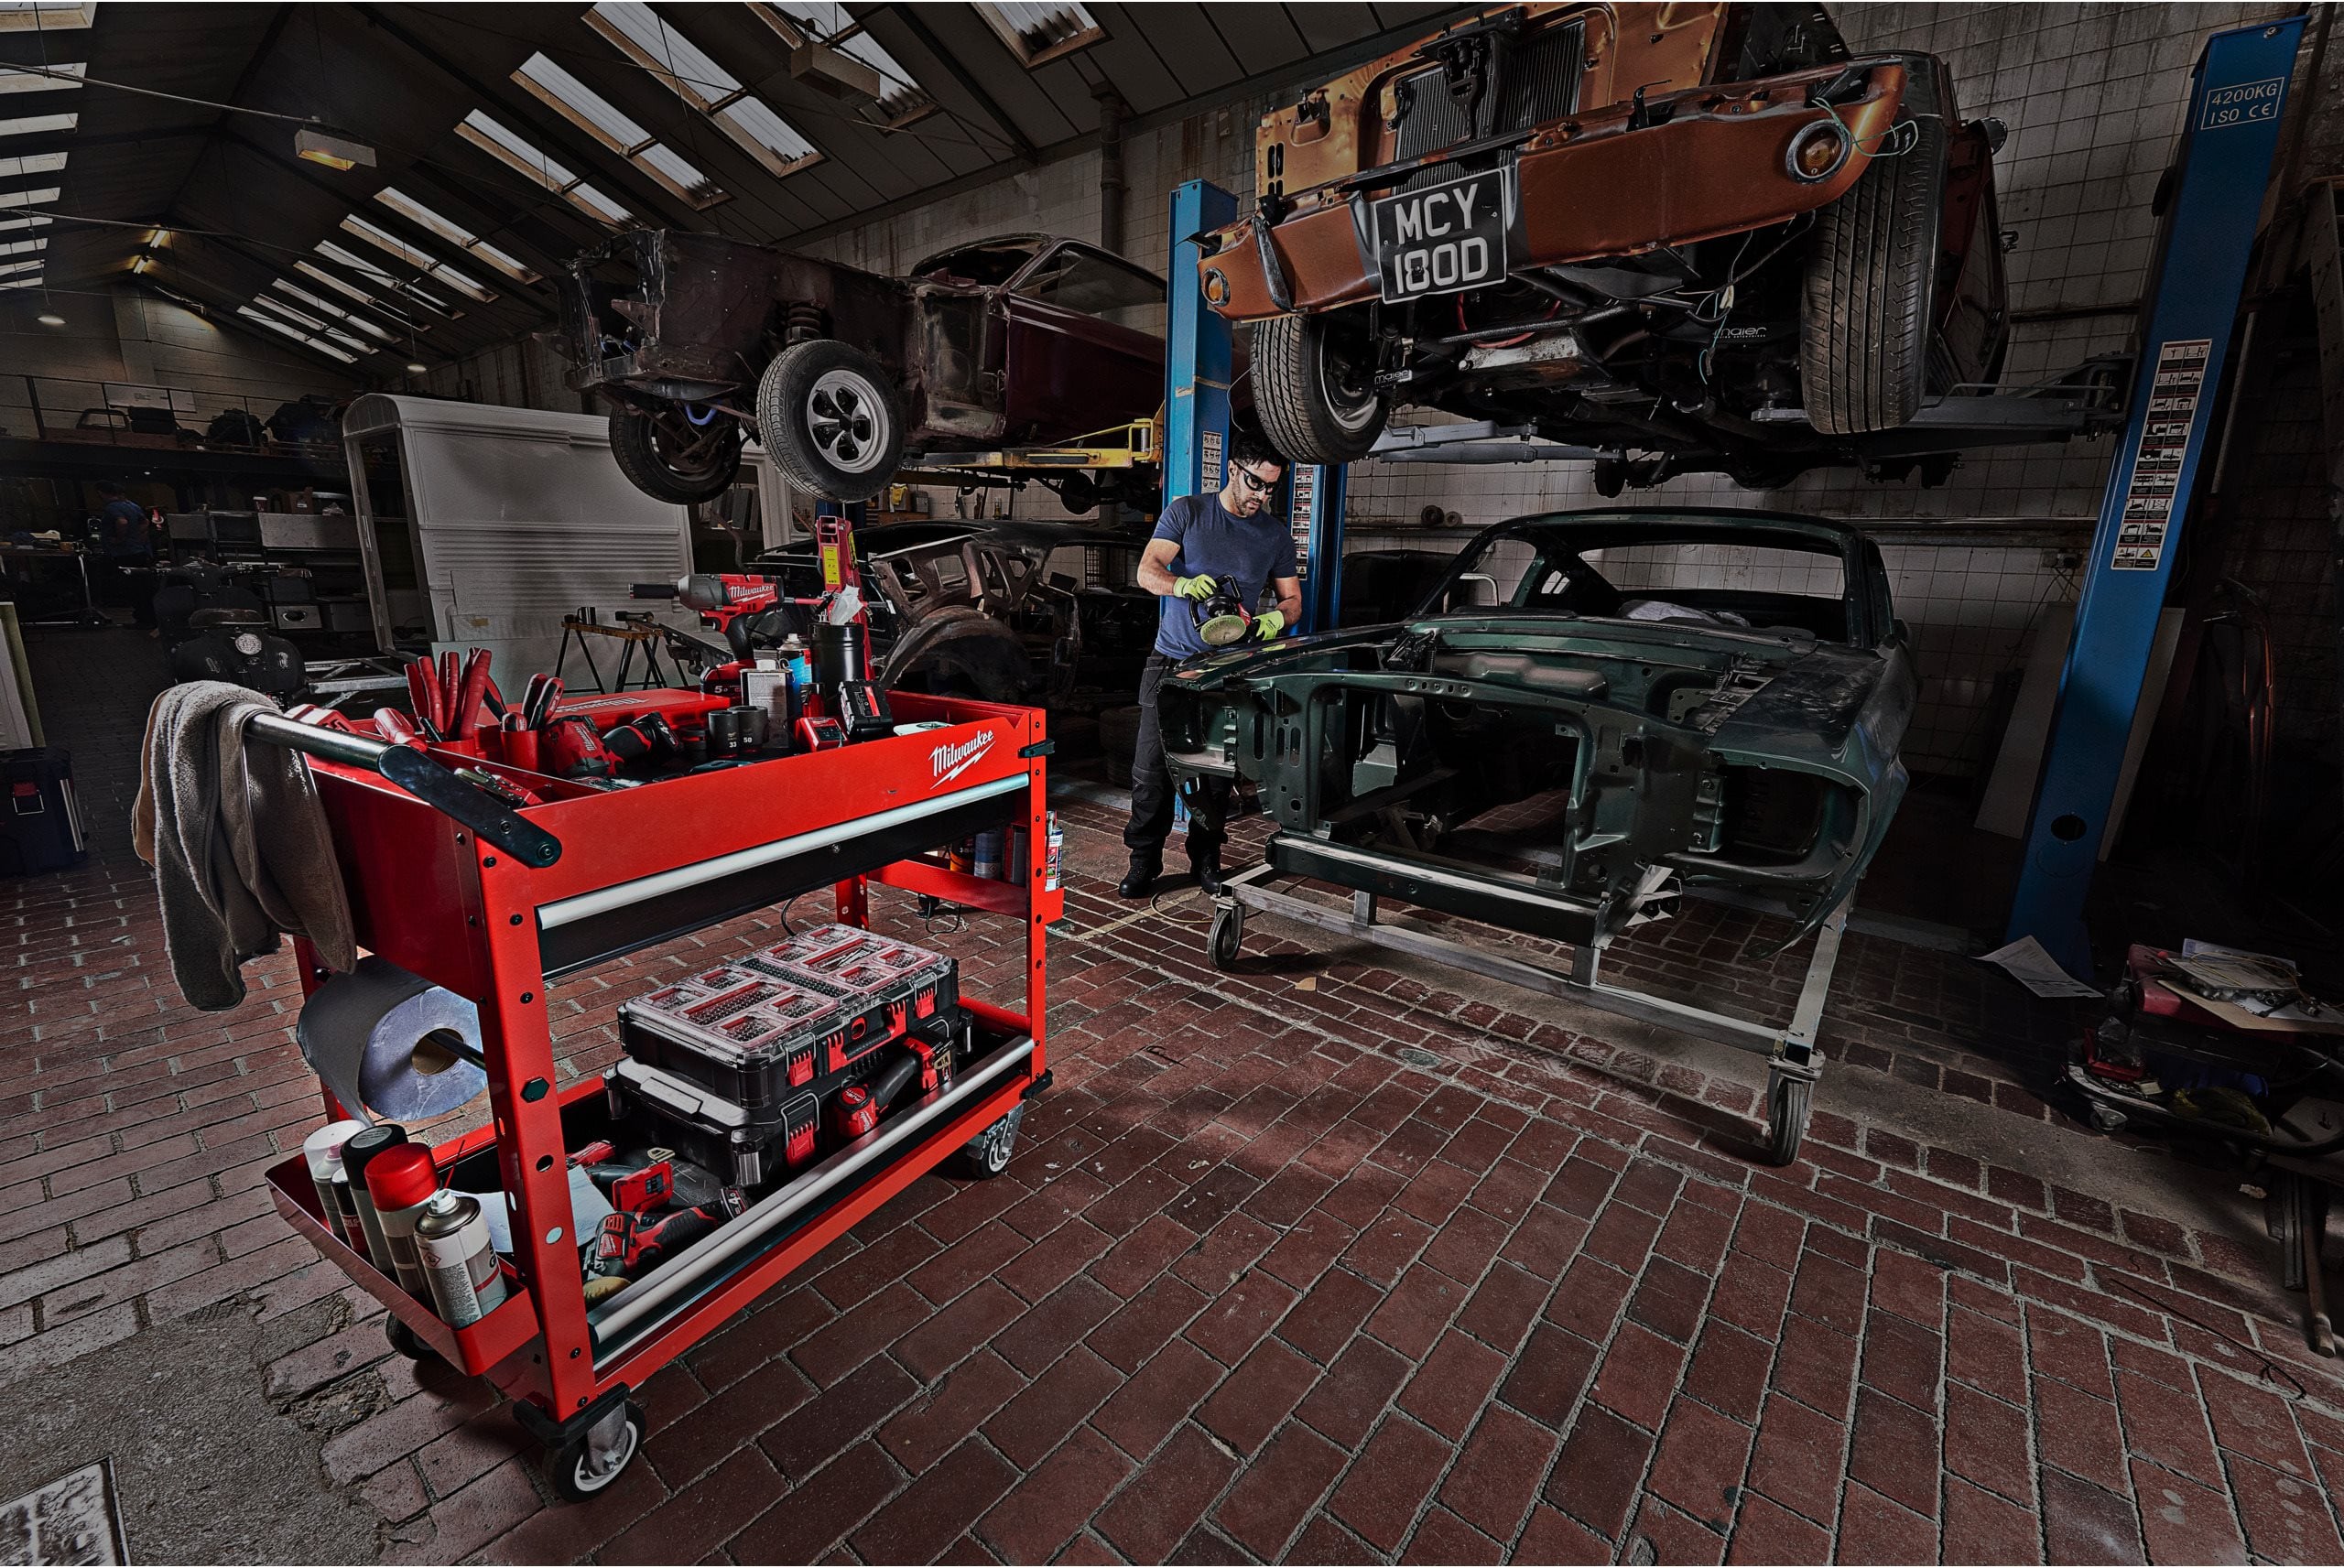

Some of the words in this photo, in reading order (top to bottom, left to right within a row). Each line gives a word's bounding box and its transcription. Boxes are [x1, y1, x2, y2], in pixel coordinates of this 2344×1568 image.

[2212, 83, 2277, 105] 4200KG
[2210, 109, 2240, 124] ISO
[2249, 103, 2272, 117] CE
[1394, 183, 1478, 245] MCY
[1394, 236, 1489, 294] 180D
[729, 585, 774, 599] Milwaukee
[928, 730, 995, 777] Milwaukee
